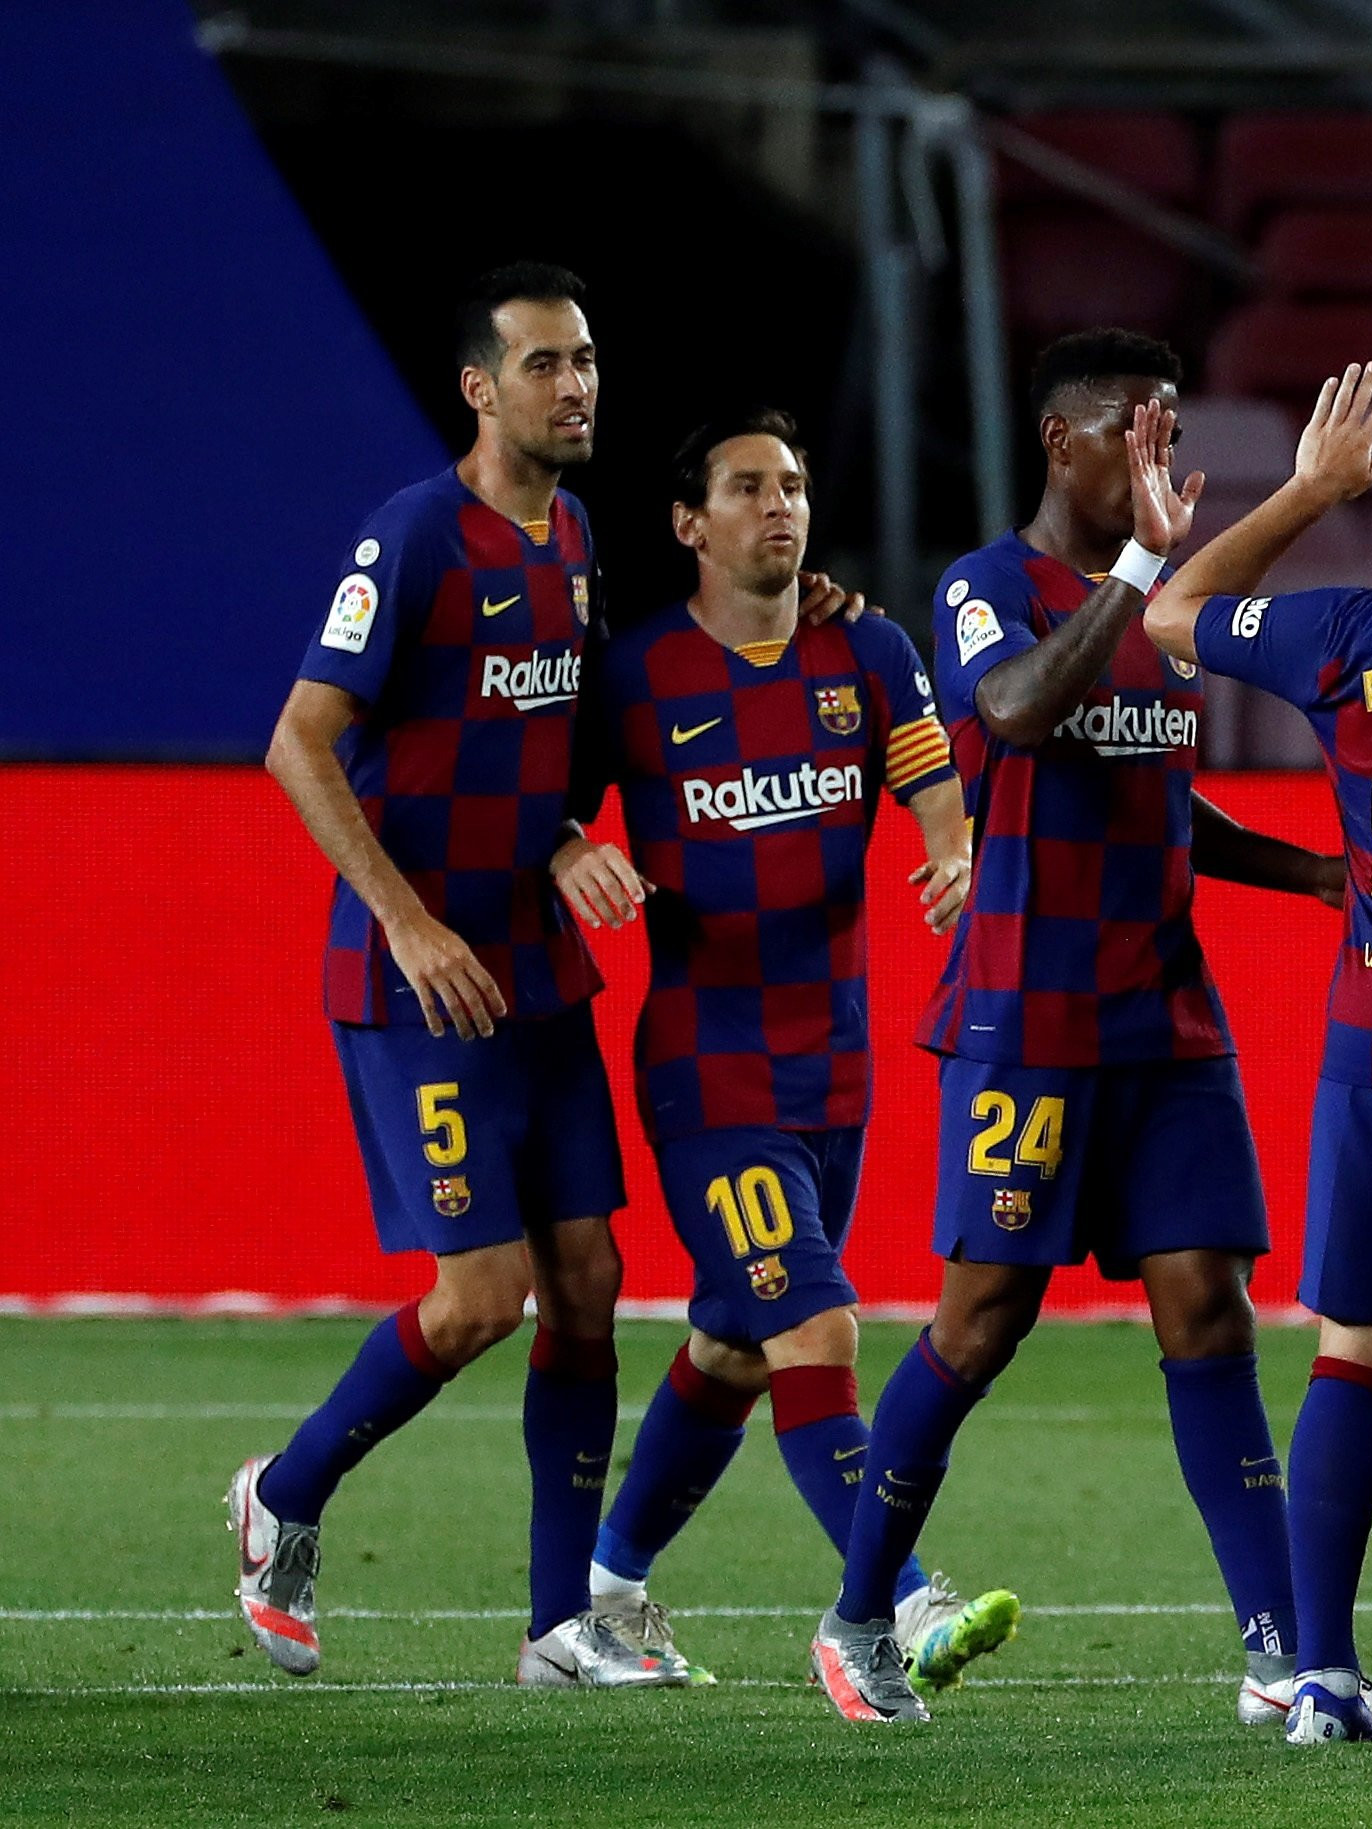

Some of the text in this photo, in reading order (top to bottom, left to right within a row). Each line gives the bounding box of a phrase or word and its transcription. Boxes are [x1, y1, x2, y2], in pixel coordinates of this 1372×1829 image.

[481, 648, 581, 698] Rakute
[683, 762, 863, 824] Rakuten
[415, 1081, 468, 1168] 5
[968, 1089, 1066, 1181] 24
[704, 1165, 795, 1260] 10
[1323, 1721, 1335, 1739] 8
